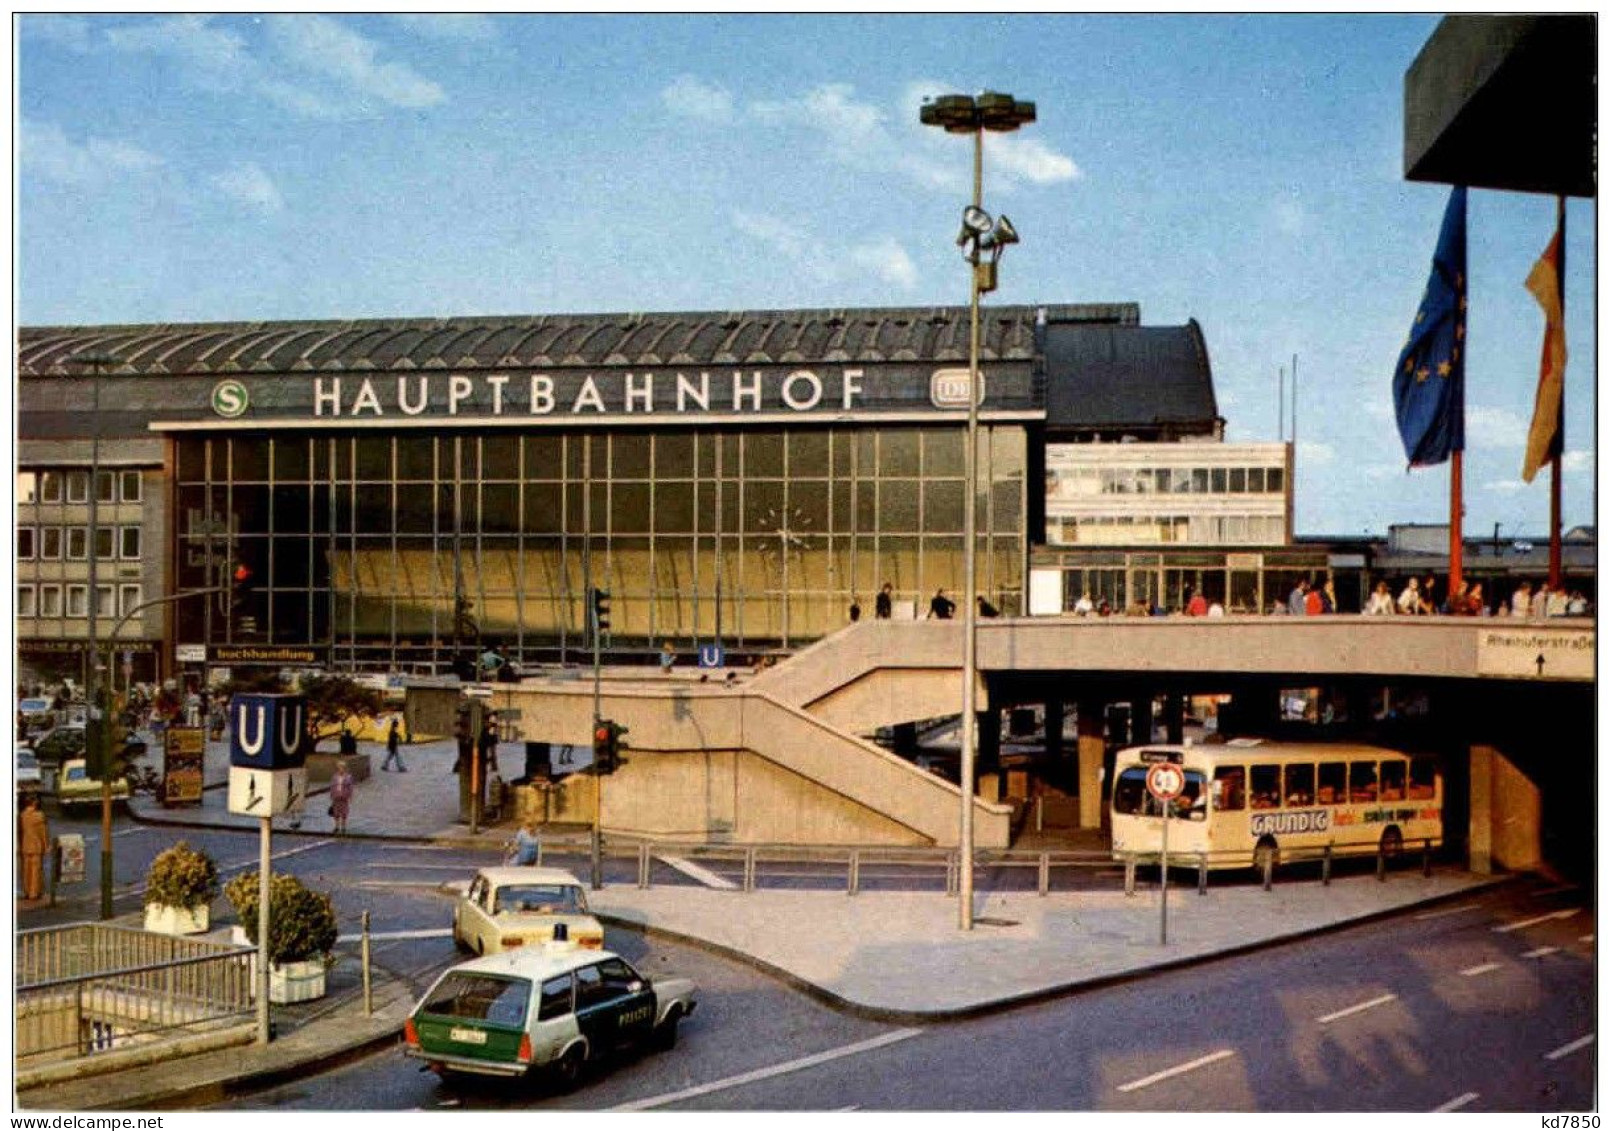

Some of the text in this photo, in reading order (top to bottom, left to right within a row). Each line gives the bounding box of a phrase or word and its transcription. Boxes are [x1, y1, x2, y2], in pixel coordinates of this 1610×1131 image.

[218, 384, 241, 412] S
[314, 369, 864, 416] HAUPTBAHNHOF
[702, 647, 720, 666] U
[239, 704, 265, 756] U
[280, 704, 302, 755] U
[1251, 810, 1328, 836] GRUNDIG
